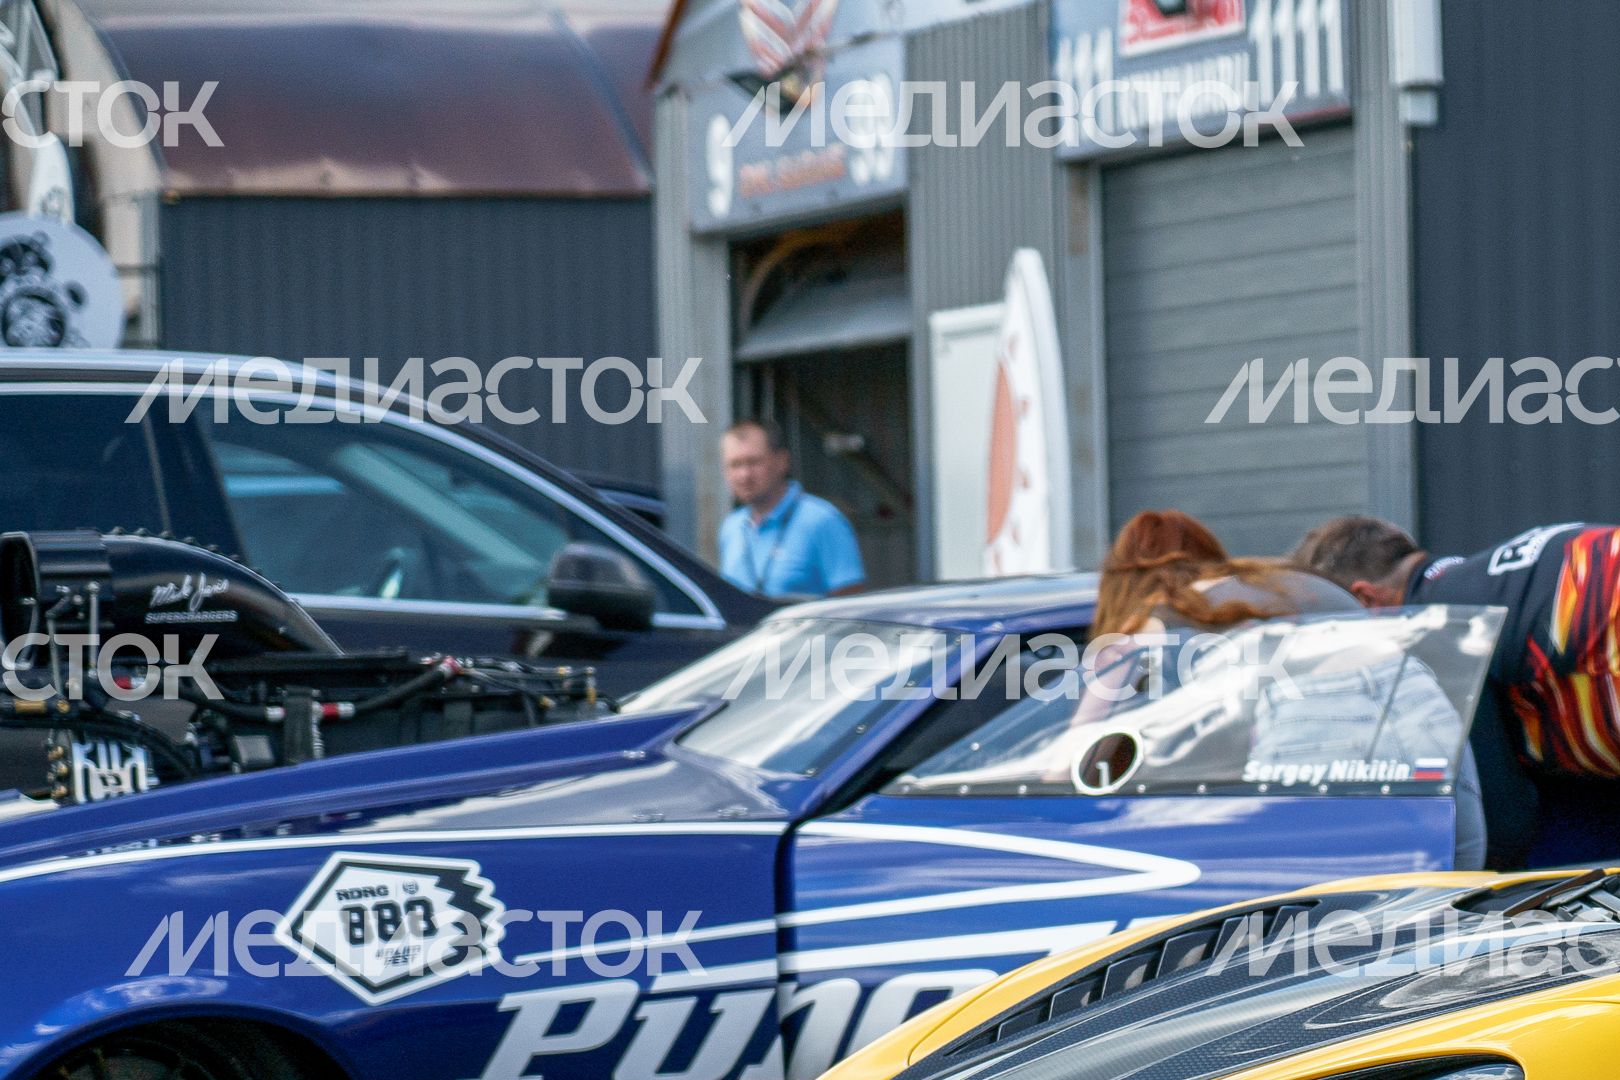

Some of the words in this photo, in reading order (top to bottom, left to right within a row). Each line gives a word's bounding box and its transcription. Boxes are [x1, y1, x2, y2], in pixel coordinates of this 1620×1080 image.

[145, 611, 238, 624] SUPERCHARGERS
[1242, 759, 1329, 787] Sergey
[1328, 758, 1410, 782] Nikitin
